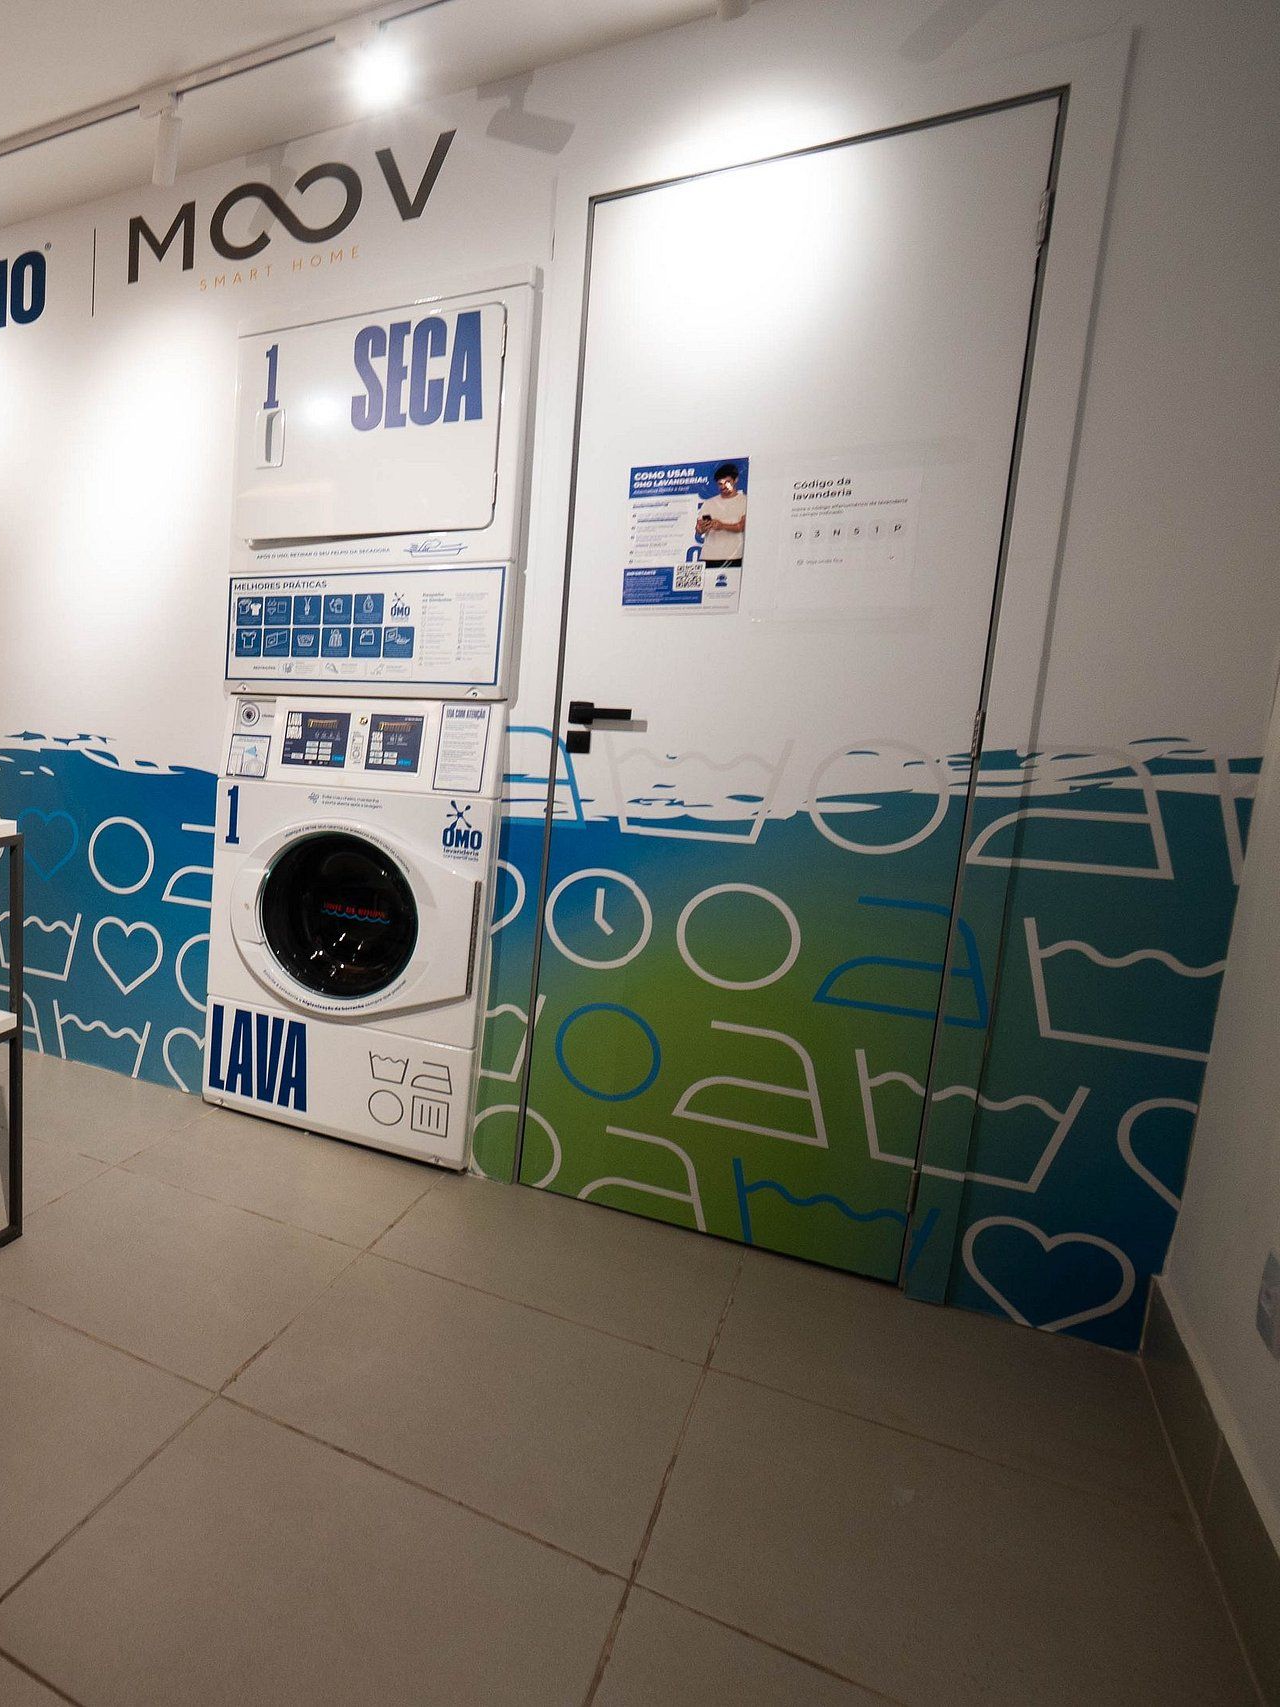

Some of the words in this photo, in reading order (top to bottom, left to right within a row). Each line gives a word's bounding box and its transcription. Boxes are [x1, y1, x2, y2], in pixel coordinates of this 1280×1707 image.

[128, 128, 456, 284] MOOV
[200, 265, 275, 292] SMART
[291, 245, 362, 275] HOME
[263, 344, 279, 409] 1
[351, 311, 483, 432] SECA
[633, 480, 652, 489] OMO
[634, 471, 665, 481] COMO
[667, 468, 695, 479] USAR
[793, 478, 834, 490] Código
[836, 477, 851, 486] da
[792, 488, 852, 501] lavanderia
[234, 582, 280, 591] MELHORES
[283, 579, 327, 590] PRÁTICAS
[390, 606, 411, 617] OMO
[225, 785, 240, 844] 1
[442, 828, 482, 850] OMO
[208, 1004, 307, 1112] LAVA
